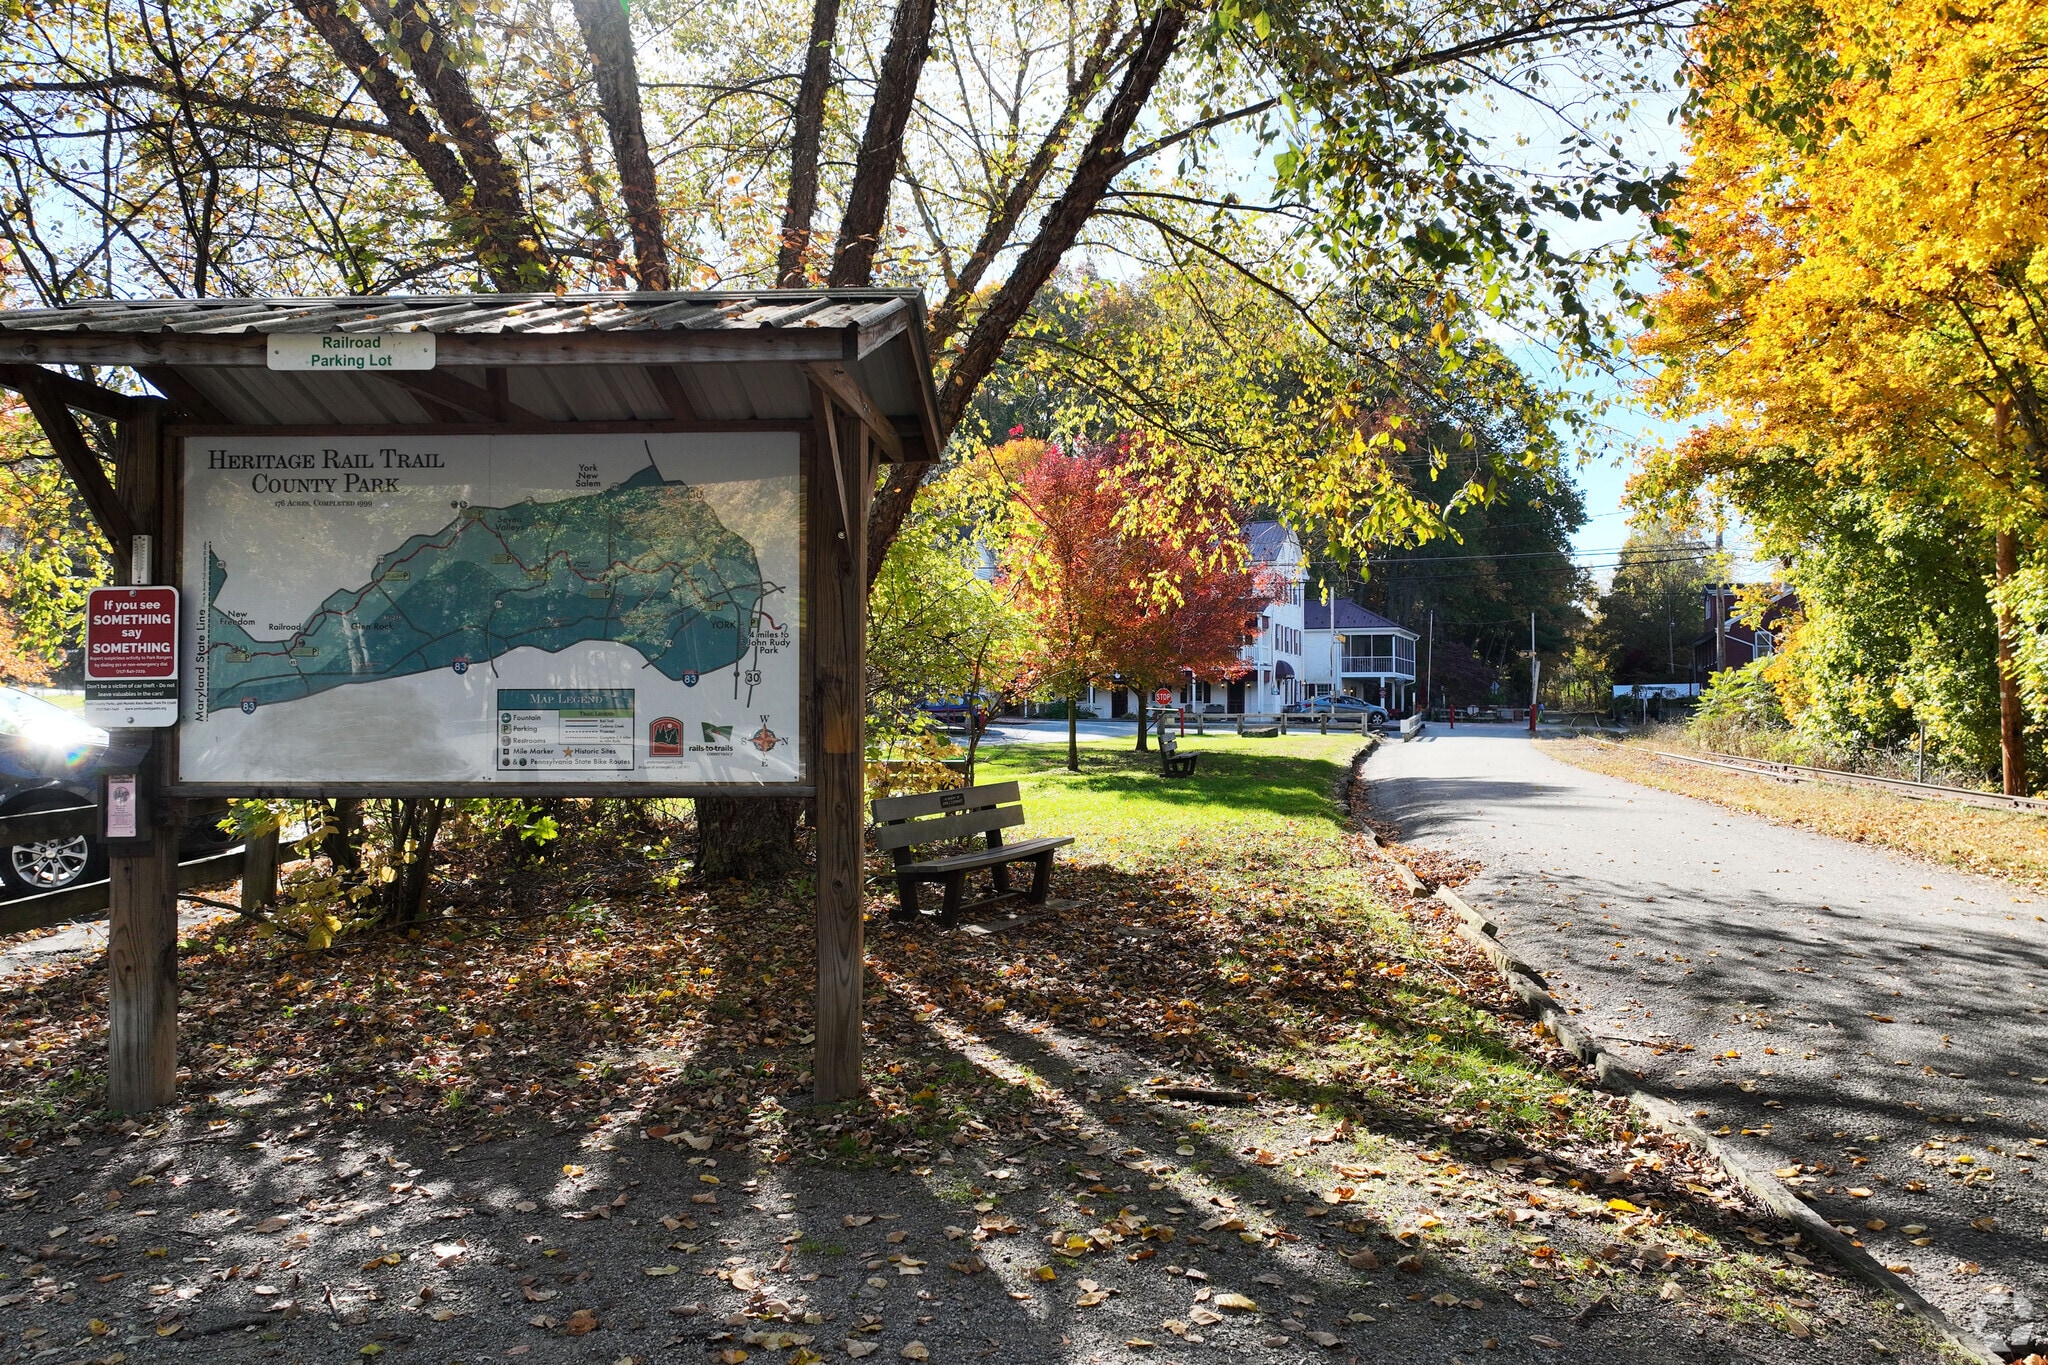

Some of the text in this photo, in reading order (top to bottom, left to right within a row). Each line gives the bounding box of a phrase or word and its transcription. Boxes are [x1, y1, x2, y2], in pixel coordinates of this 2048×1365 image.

[322, 336, 381, 349] Railroad
[311, 354, 392, 369] Parking Lot
[207, 448, 445, 470] HERITAGE RAIL TRAIL
[578, 463, 598, 472] York
[578, 471, 598, 480] New
[251, 473, 400, 494] COUNTY PARK
[575, 479, 601, 488] Salem
[356, 500, 373, 508] 1999
[497, 515, 522, 524] Seven
[495, 523, 525, 532] Valleys
[104, 600, 161, 613] If you see
[227, 610, 248, 618] New
[93, 614, 171, 625] SOMETHING
[219, 618, 256, 626] Freedom
[268, 623, 302, 631] Railroad
[351, 622, 394, 631] Glen Rock
[711, 620, 736, 629] YORK
[121, 628, 142, 640] say
[92, 642, 171, 654] SOMETHING
[748, 639, 791, 648] John Rudy
[760, 646, 779, 654] Park
[194, 609, 206, 722] Maryland State Line
[454, 662, 467, 671] 83
[684, 674, 697, 684] 83
[747, 672, 759, 683] 30
[530, 694, 603, 703] MAP LEGEND
[1156, 693, 1171, 701] STOP
[242, 702, 255, 711] 83
[760, 715, 770, 723] W
[513, 725, 538, 733] Parking
[741, 737, 747, 745] S
[781, 737, 789, 745] N
[530, 758, 573, 766] Pennsylvania
